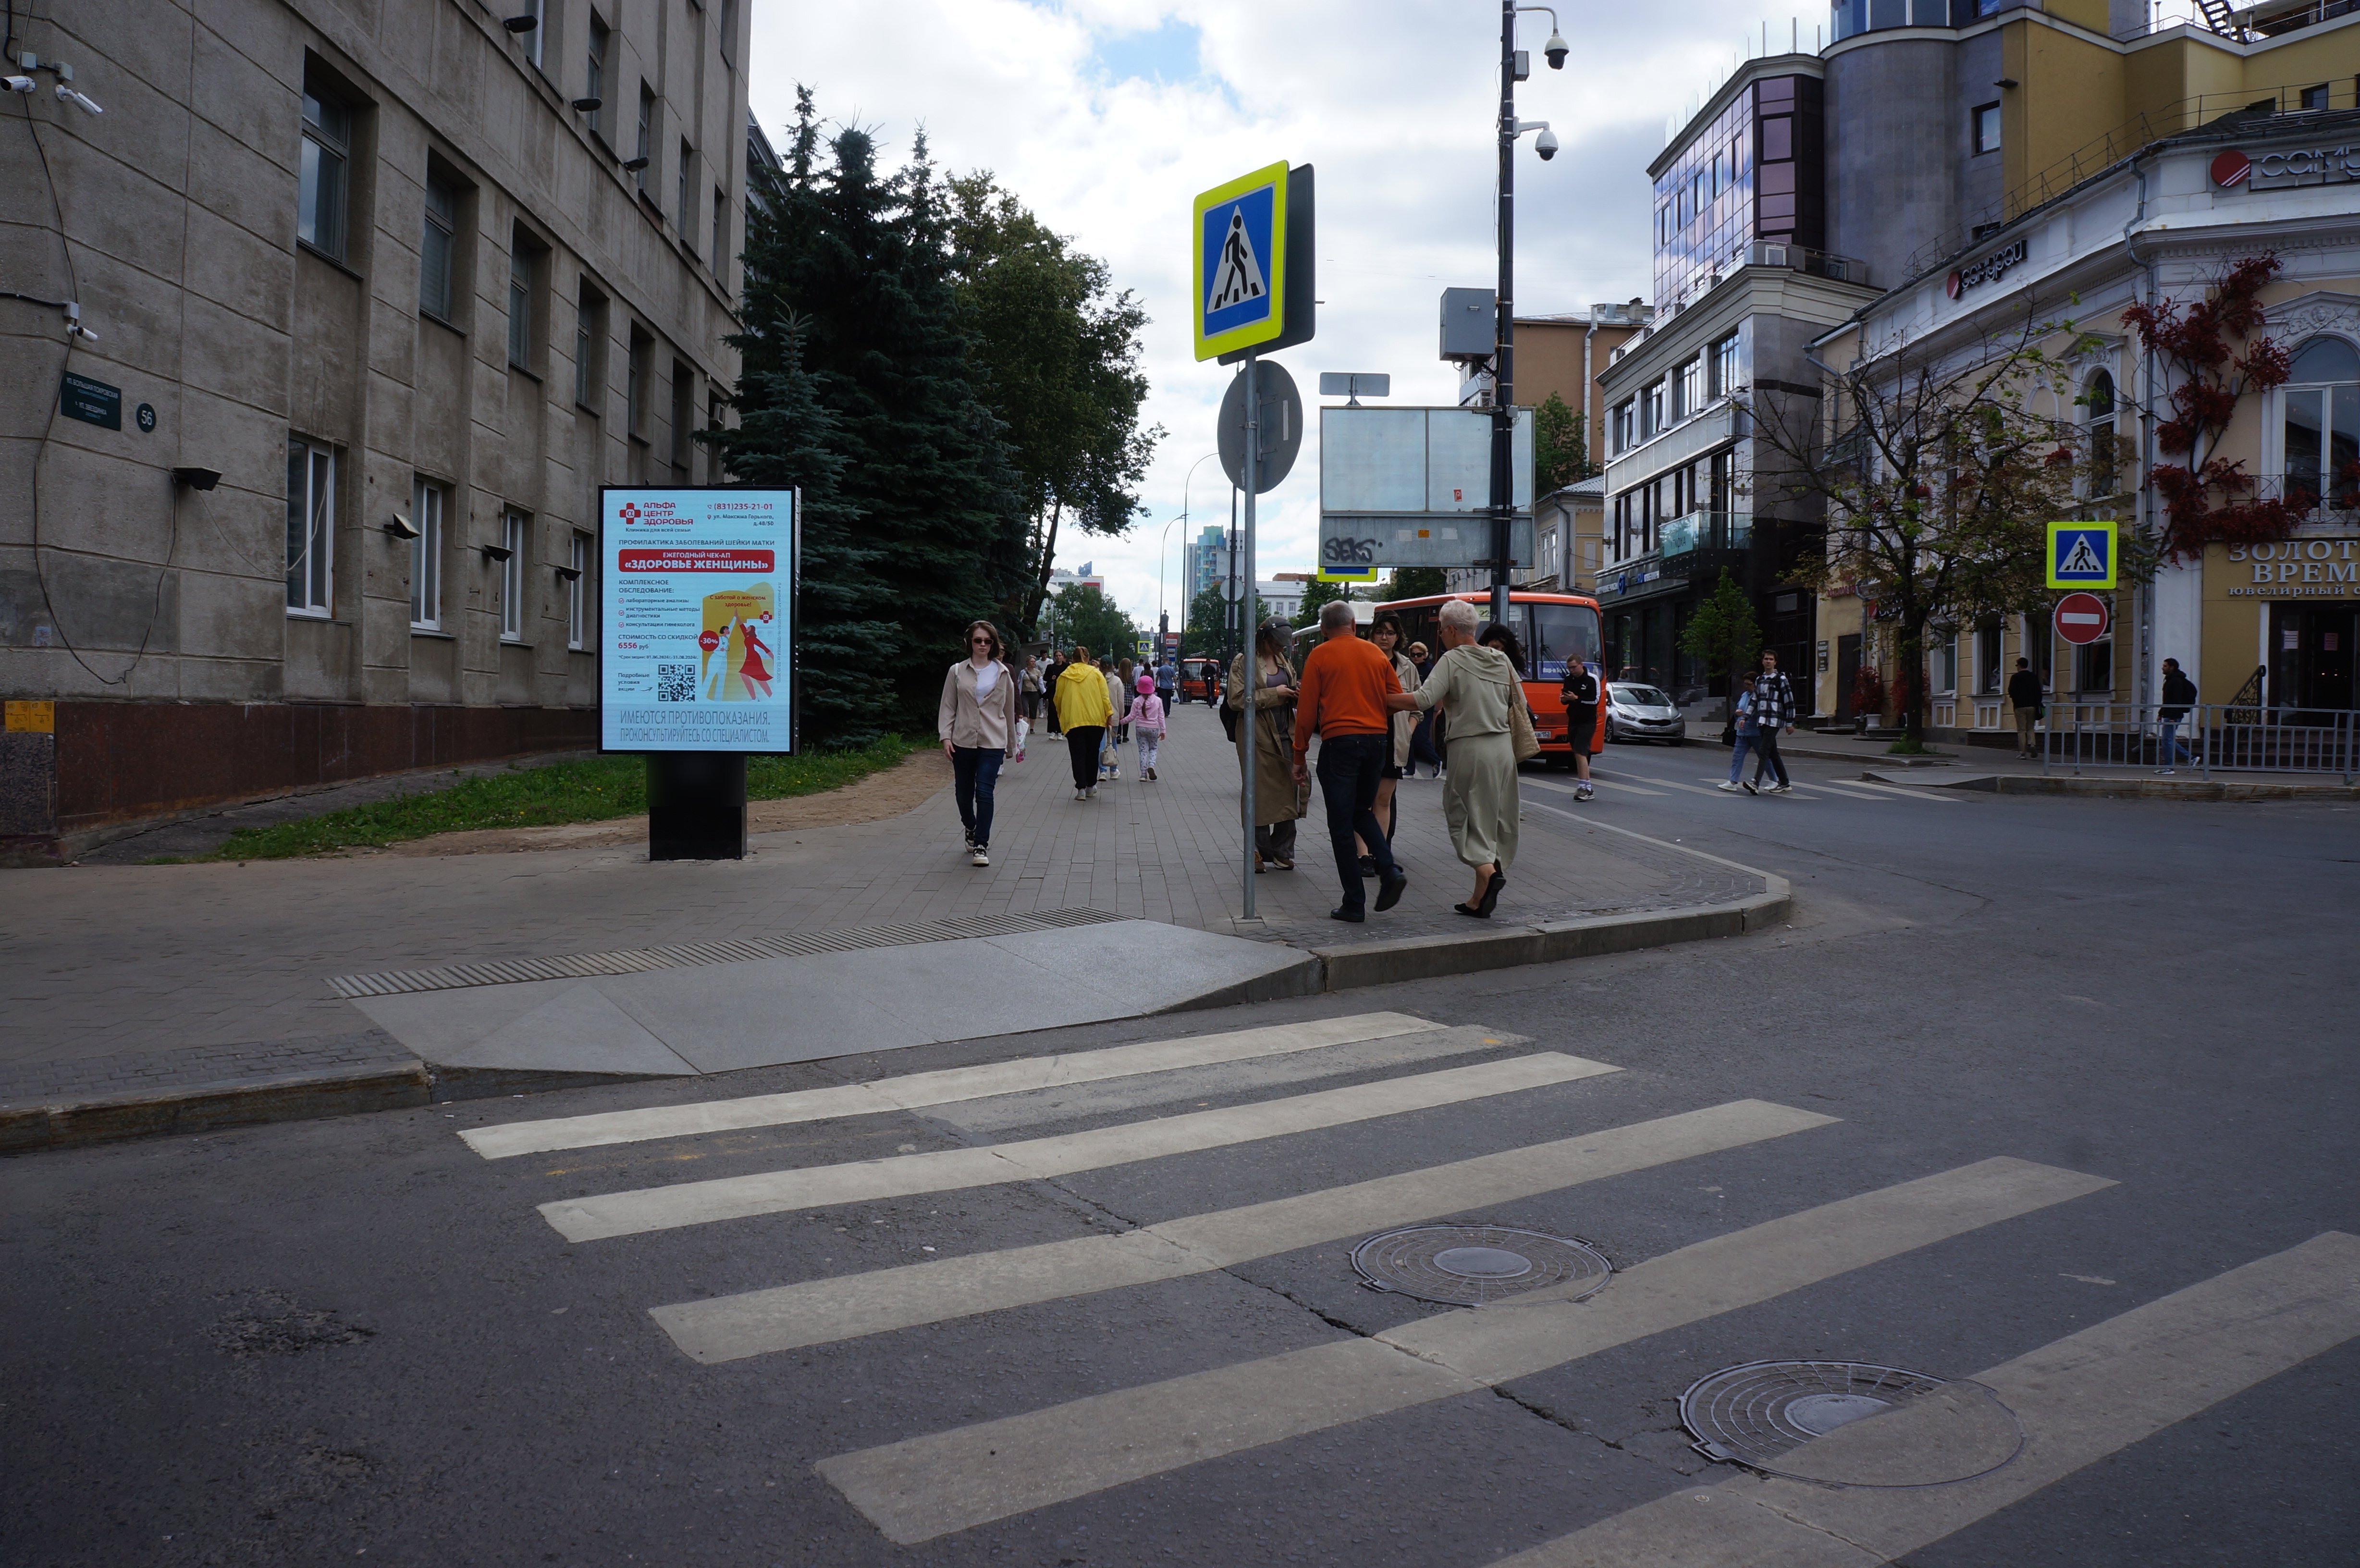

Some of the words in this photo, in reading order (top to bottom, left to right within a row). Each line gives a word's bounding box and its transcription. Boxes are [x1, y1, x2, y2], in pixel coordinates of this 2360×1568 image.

[141, 410, 152, 426] 56
[625, 560, 691, 570] «ЗДОРОВЬЕ
[693, 560, 768, 570] ЖЕНЩИНЫ»
[2252, 563, 2359, 583] ВРЕМ
[2229, 584, 2345, 598] ювелирный
[620, 710, 666, 724] ИМЕЮТСЯ
[668, 711, 770, 725] ПРОТИВОПОКАЗАНИЯ.
[620, 725, 701, 742] ПРОКОНСУЛЬТИРУЙТЕСЬ
[701, 728, 711, 742] СО
[713, 728, 769, 745] СПЕЦИАЛИСТОМ.
